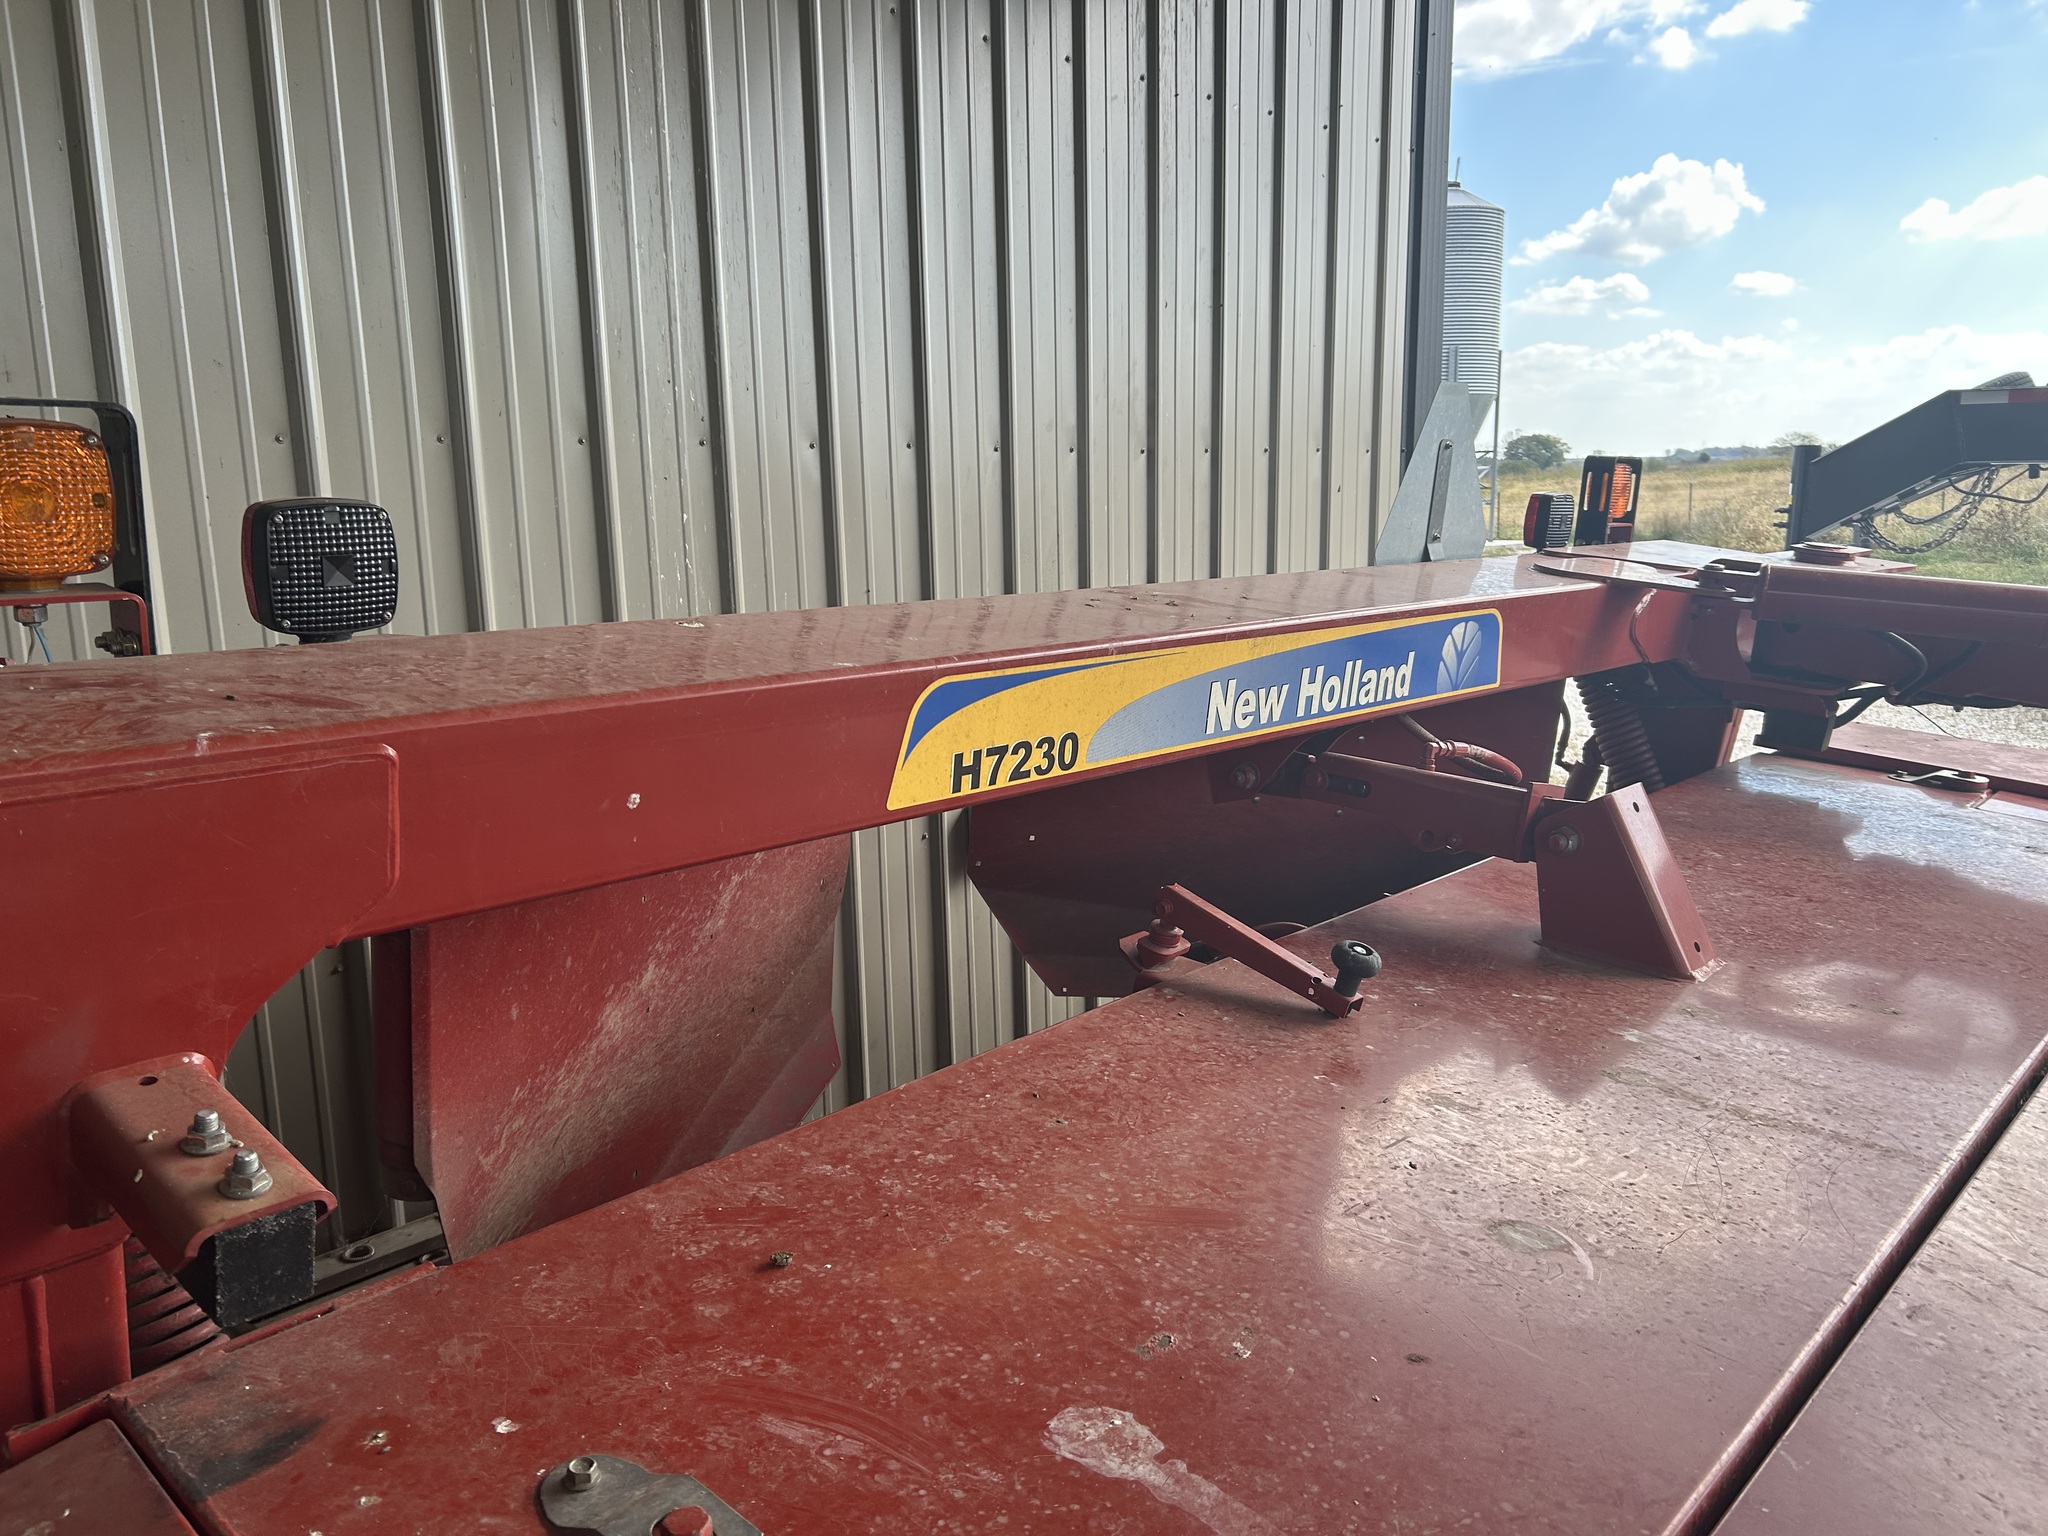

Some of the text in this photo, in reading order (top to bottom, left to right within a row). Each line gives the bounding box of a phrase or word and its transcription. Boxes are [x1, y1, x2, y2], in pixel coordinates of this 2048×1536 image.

[1205, 651, 1415, 735] New Holland
[951, 731, 1079, 794] H7230
